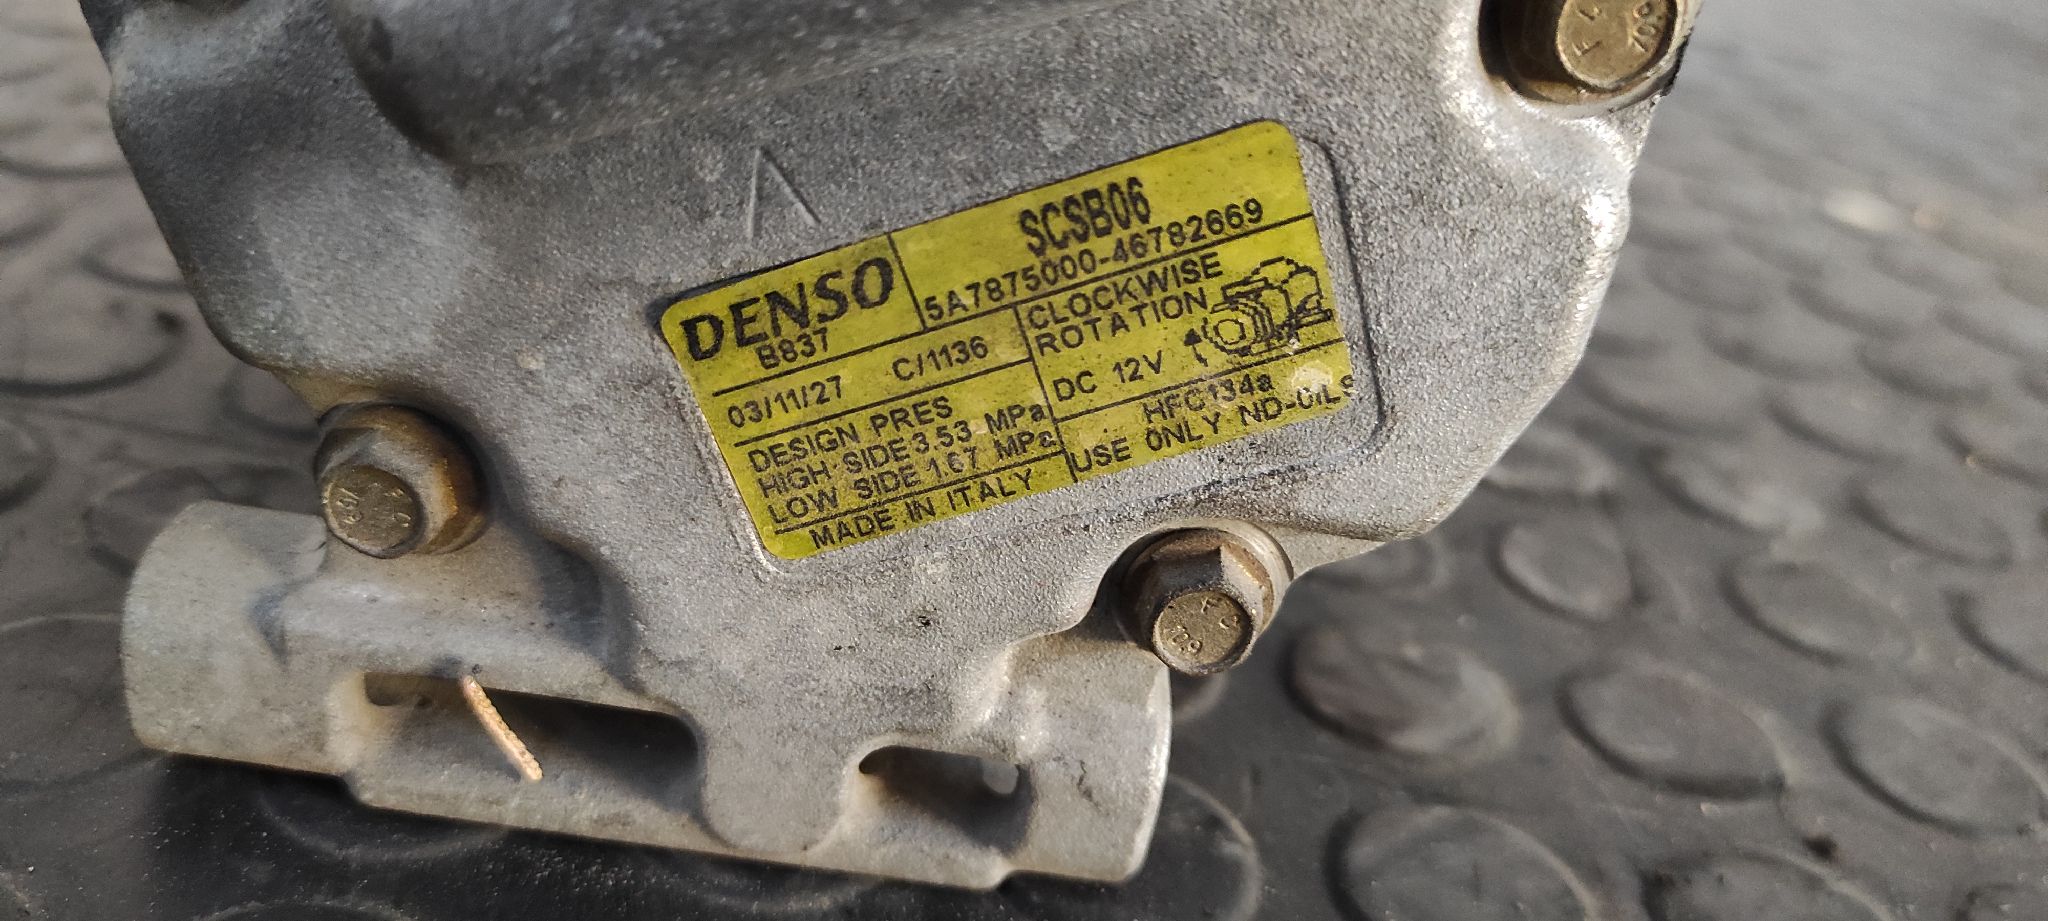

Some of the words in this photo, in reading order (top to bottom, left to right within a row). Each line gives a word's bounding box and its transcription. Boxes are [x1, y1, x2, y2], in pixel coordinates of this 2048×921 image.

[1019, 176, 1151, 257] SCSB06
[923, 197, 1264, 322] 5A7875000-46782669
[1027, 251, 1224, 330] CLOCKWISE
[679, 257, 895, 361] DENSO
[755, 326, 829, 370] B837
[1034, 286, 1208, 356] ROTATION
[727, 374, 842, 428] 03/11/27
[892, 335, 989, 381] C/1136
[1053, 370, 1097, 402] DC
[1112, 350, 1162, 383] 12V
[747, 422, 861, 473] DESIGN
[869, 395, 954, 437] PRES
[757, 460, 832, 498] HIGH
[843, 437, 911, 475] SIDE
[912, 419, 972, 455] 3.53
[984, 403, 1048, 436] MPa
[1070, 436, 1132, 473] USE
[1145, 411, 1221, 451] ONLY
[768, 486, 839, 524] LOW
[853, 463, 921, 500] SIDE
[993, 430, 1057, 461] MPa
[809, 507, 896, 549] MADE
[905, 496, 936, 523] IN
[947, 467, 1032, 511] ITALY
